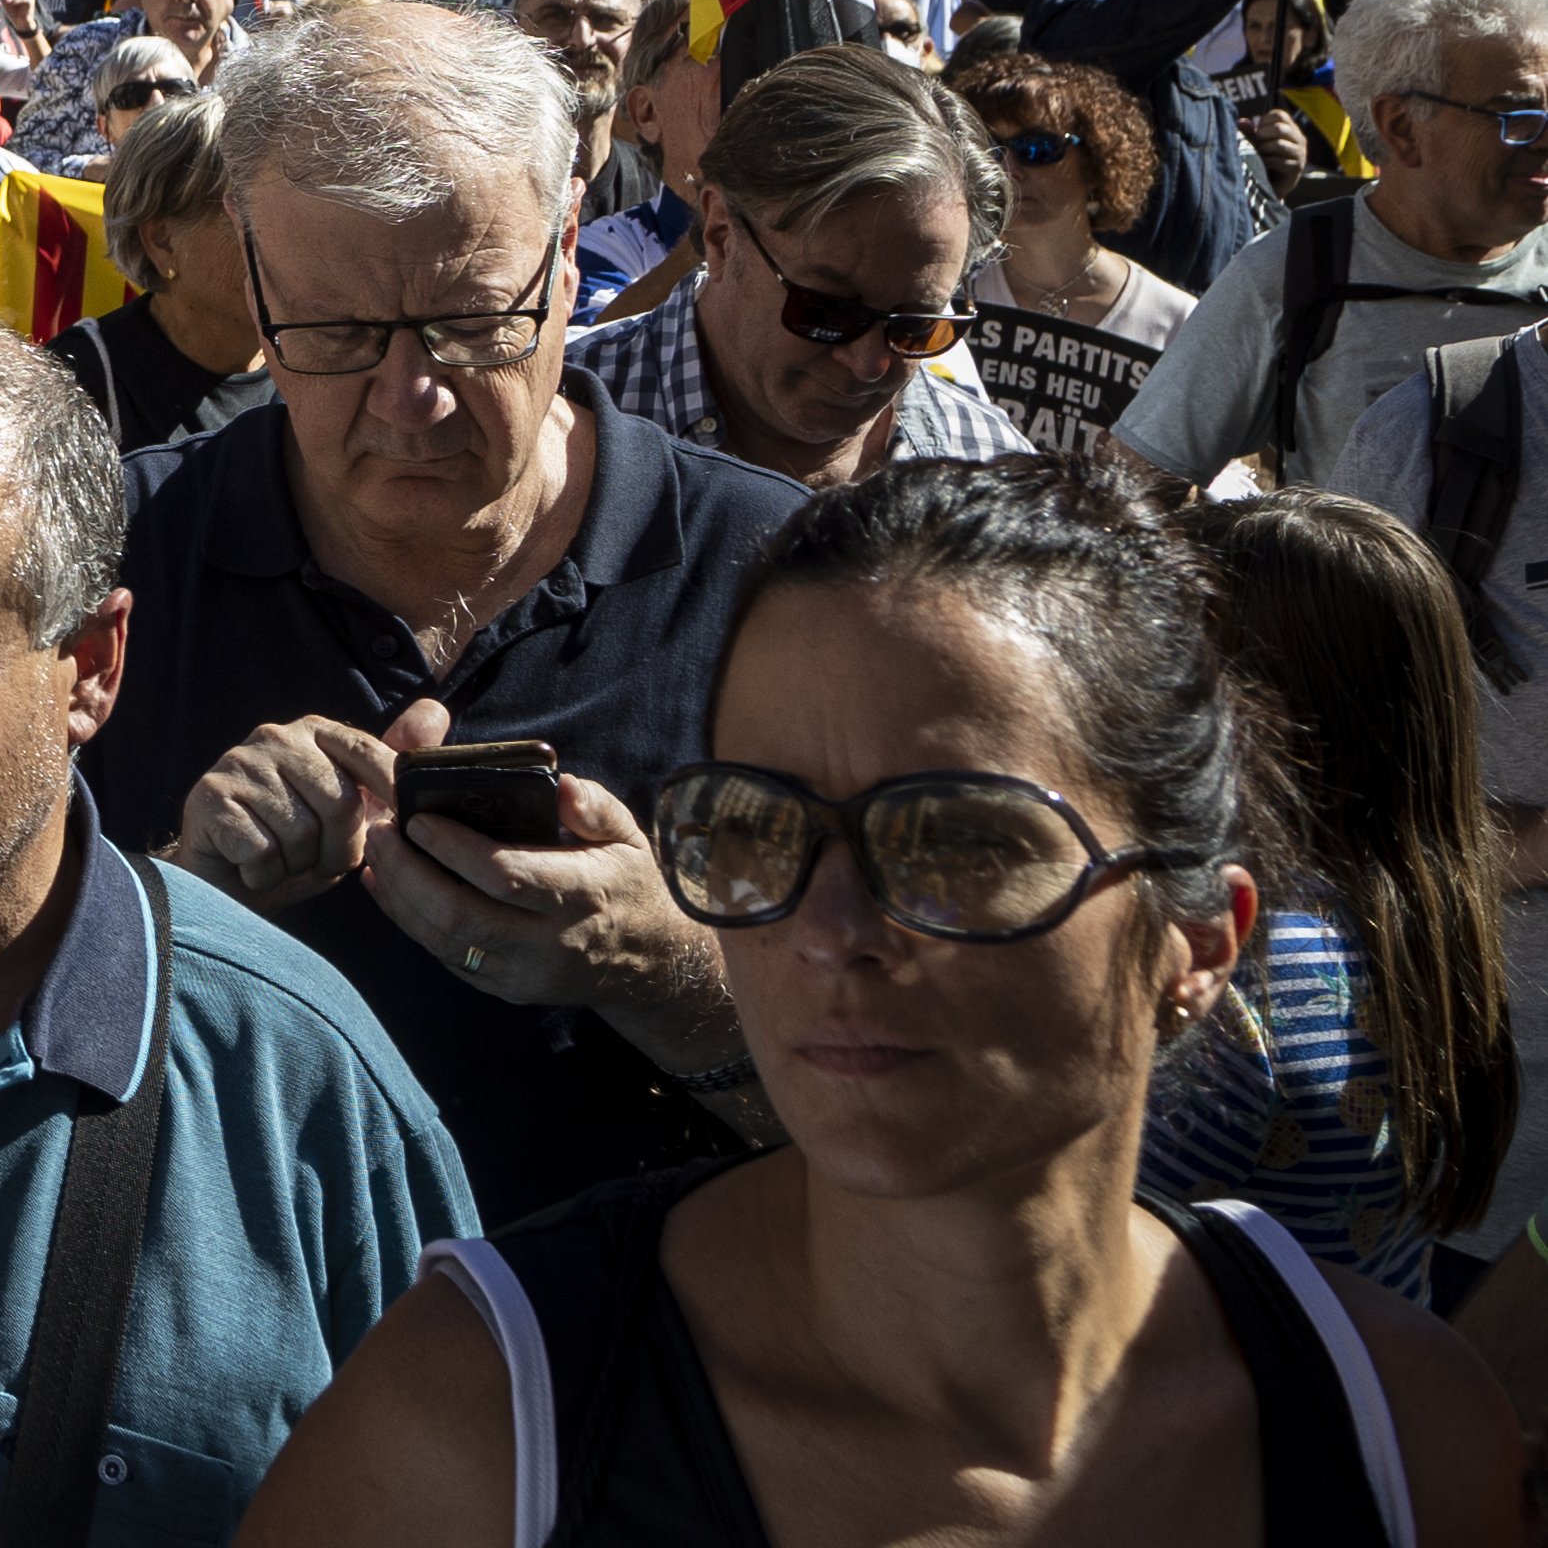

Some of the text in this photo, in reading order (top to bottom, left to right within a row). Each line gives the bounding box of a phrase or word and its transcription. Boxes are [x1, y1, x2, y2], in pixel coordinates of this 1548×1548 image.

[981, 359, 1101, 410] ENS HEU
[1013, 325, 1151, 391] PARTITS
[996, 398, 1106, 458] RAÏT
